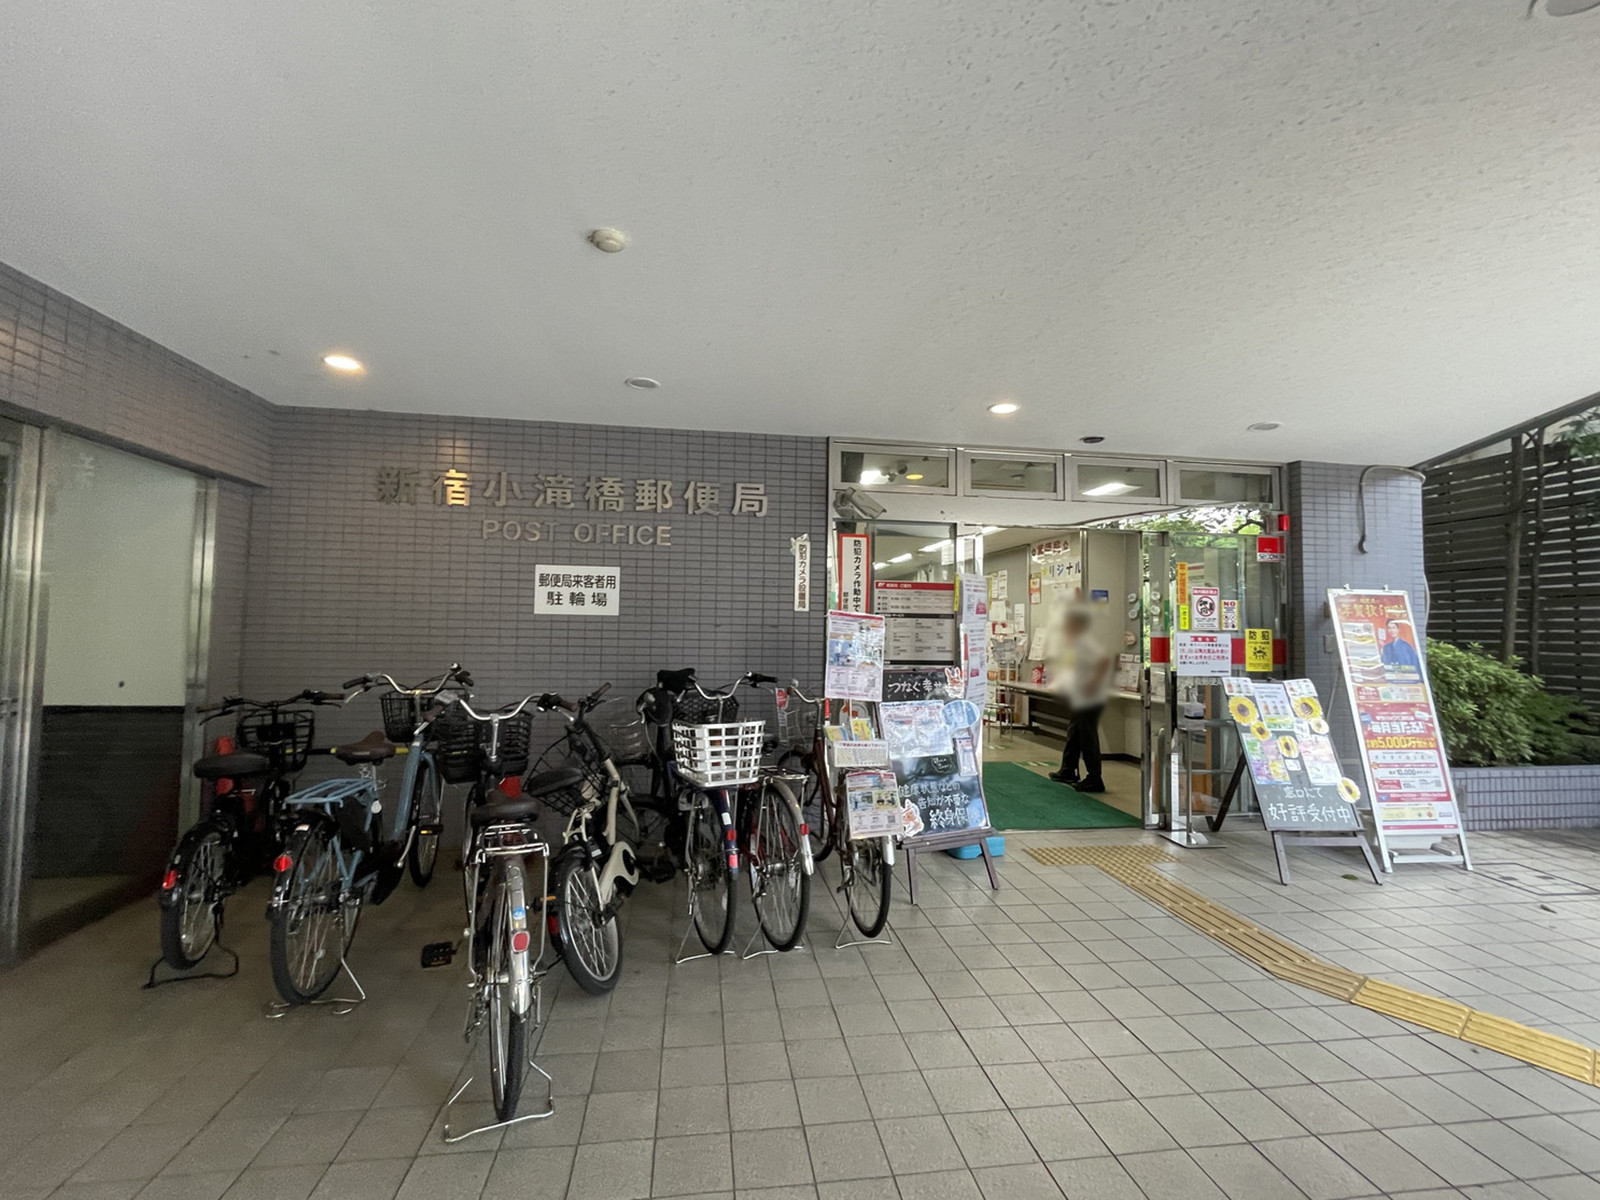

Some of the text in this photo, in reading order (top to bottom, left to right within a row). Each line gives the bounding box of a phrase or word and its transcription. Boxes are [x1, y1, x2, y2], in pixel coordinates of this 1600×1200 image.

[377, 466, 768, 518] 新宿小滝橋郵便局
[482, 519, 672, 546] POST OFFICE
[538, 573, 617, 589] 郵便局来客者用
[547, 591, 608, 607] 駐輪場
[1283, 785, 1323, 799] 窓口にて
[1268, 803, 1351, 824] 好評受付中
